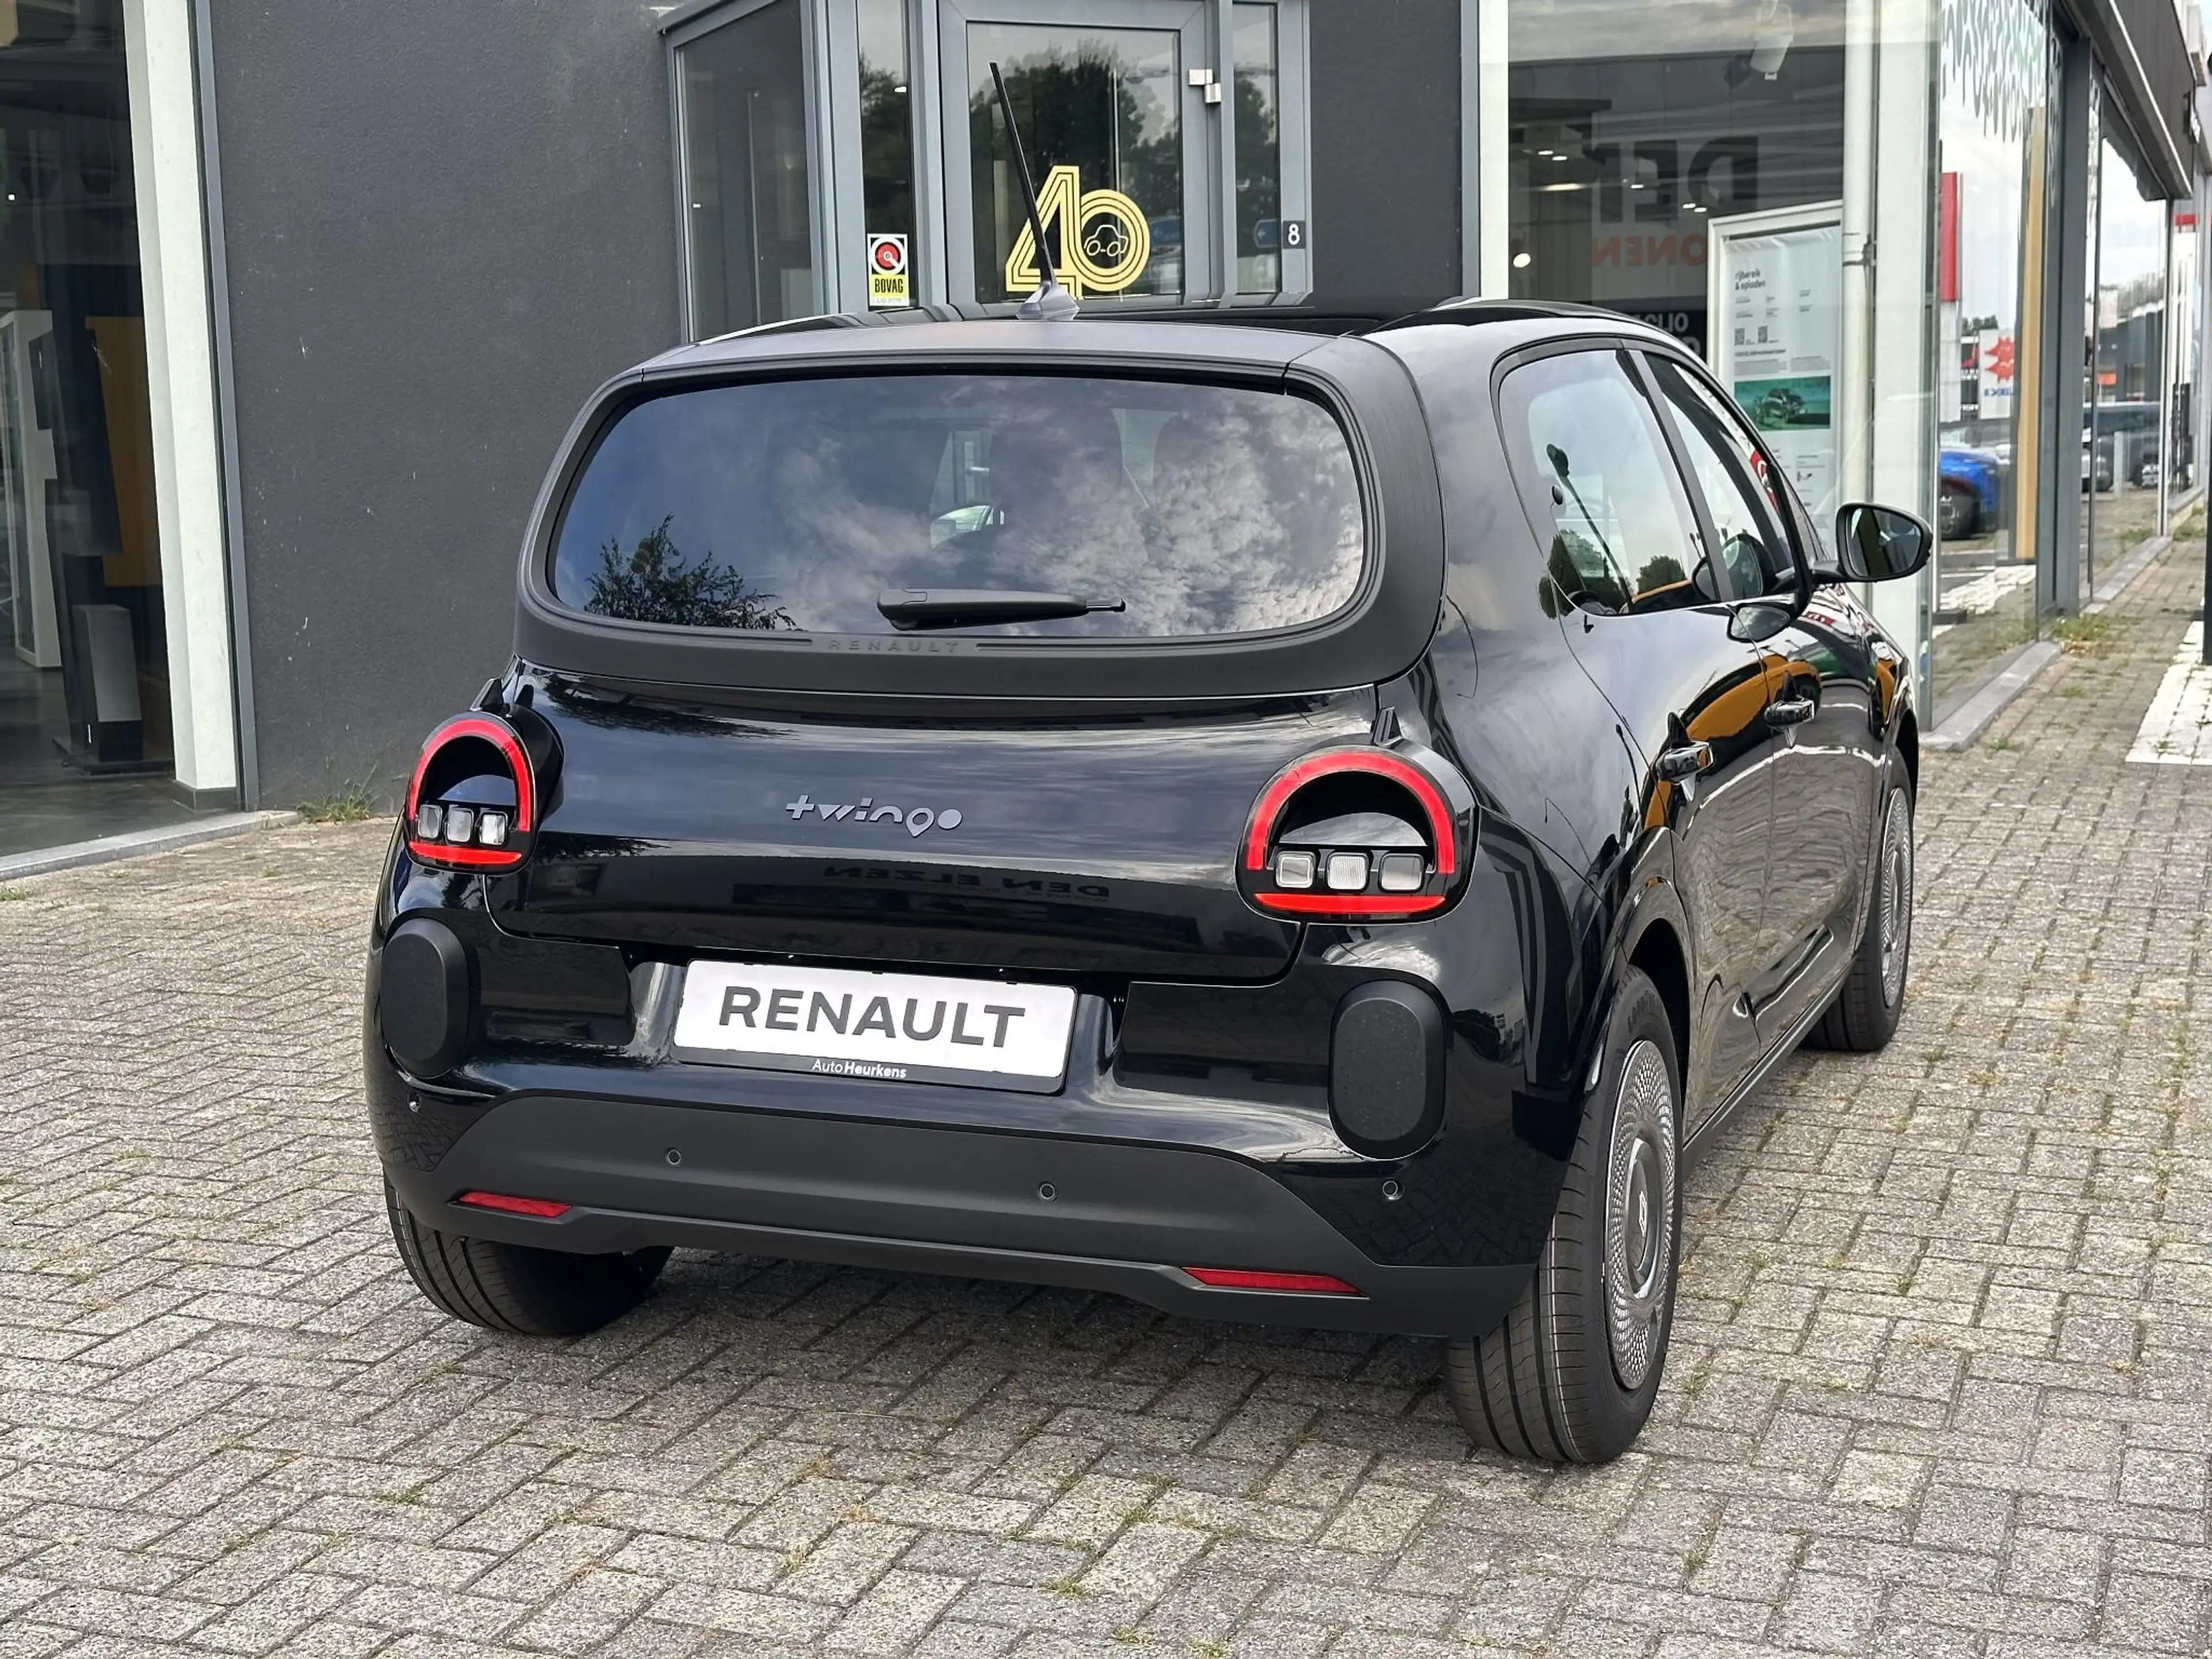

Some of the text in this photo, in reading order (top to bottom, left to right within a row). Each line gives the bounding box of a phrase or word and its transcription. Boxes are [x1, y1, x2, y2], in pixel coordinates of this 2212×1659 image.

[1006, 165, 1150, 300] 40
[1288, 225, 1301, 245] 8
[874, 278, 903, 293] BOVAG
[828, 639, 959, 653] RENAULT
[785, 794, 963, 837] twingo
[718, 985, 1025, 1048] RENAULT
